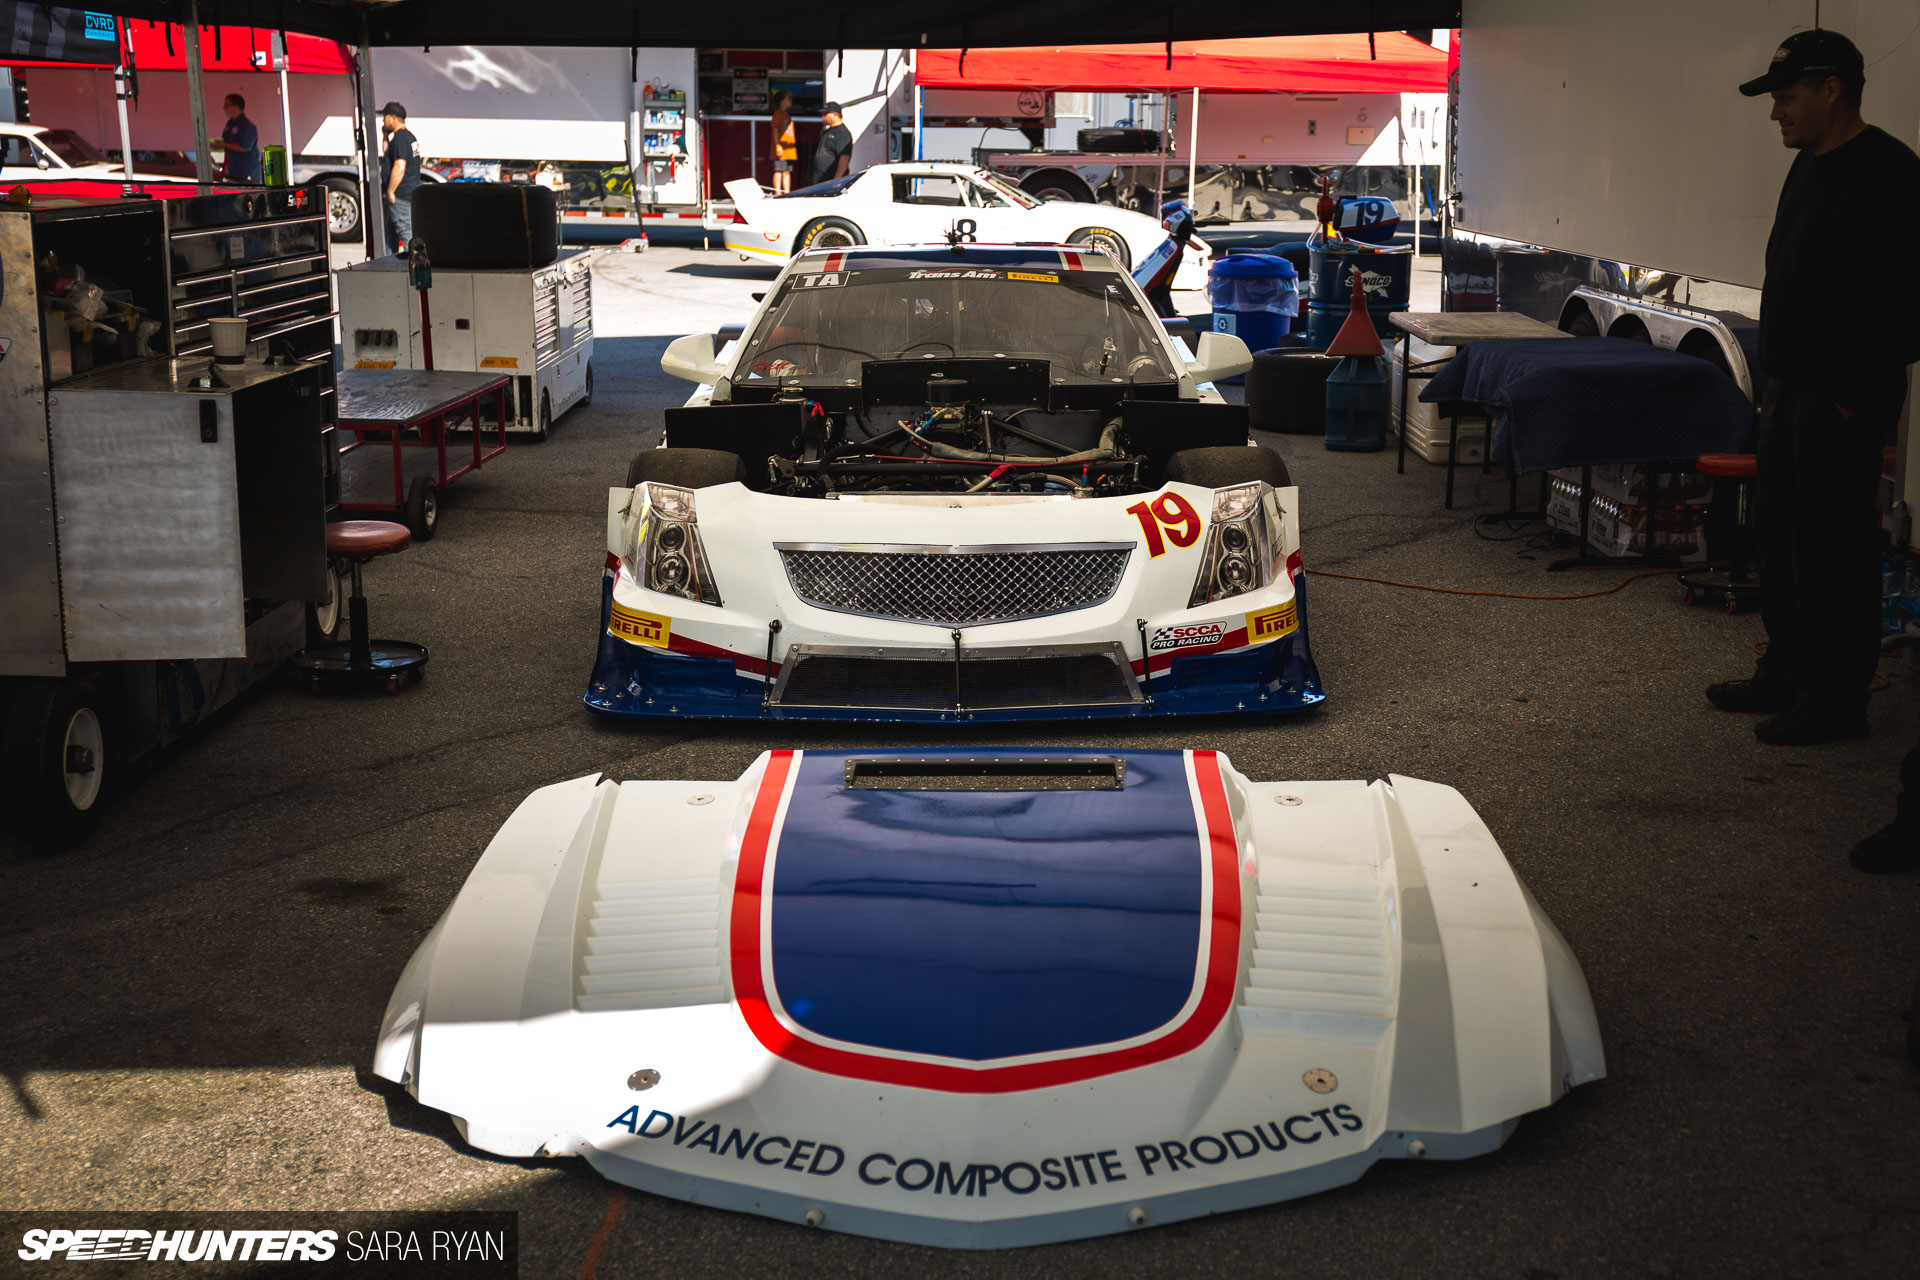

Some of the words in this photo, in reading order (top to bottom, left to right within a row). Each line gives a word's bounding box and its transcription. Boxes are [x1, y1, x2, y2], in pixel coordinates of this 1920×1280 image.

[85, 15, 115, 30] CVRD
[1354, 201, 1384, 226] 19
[957, 219, 976, 242] 8
[803, 274, 839, 287] TA
[1346, 276, 1391, 286] SNOCO
[1126, 491, 1202, 560] 19
[611, 616, 661, 640] IRELLI
[1173, 624, 1222, 638] SCCA
[1152, 640, 1174, 649] PRO
[1177, 634, 1220, 647] RACING
[606, 1104, 845, 1177] ADVANCED
[858, 1150, 1127, 1198] COMPOSITE
[1135, 1104, 1363, 1176] PRODUCTS
